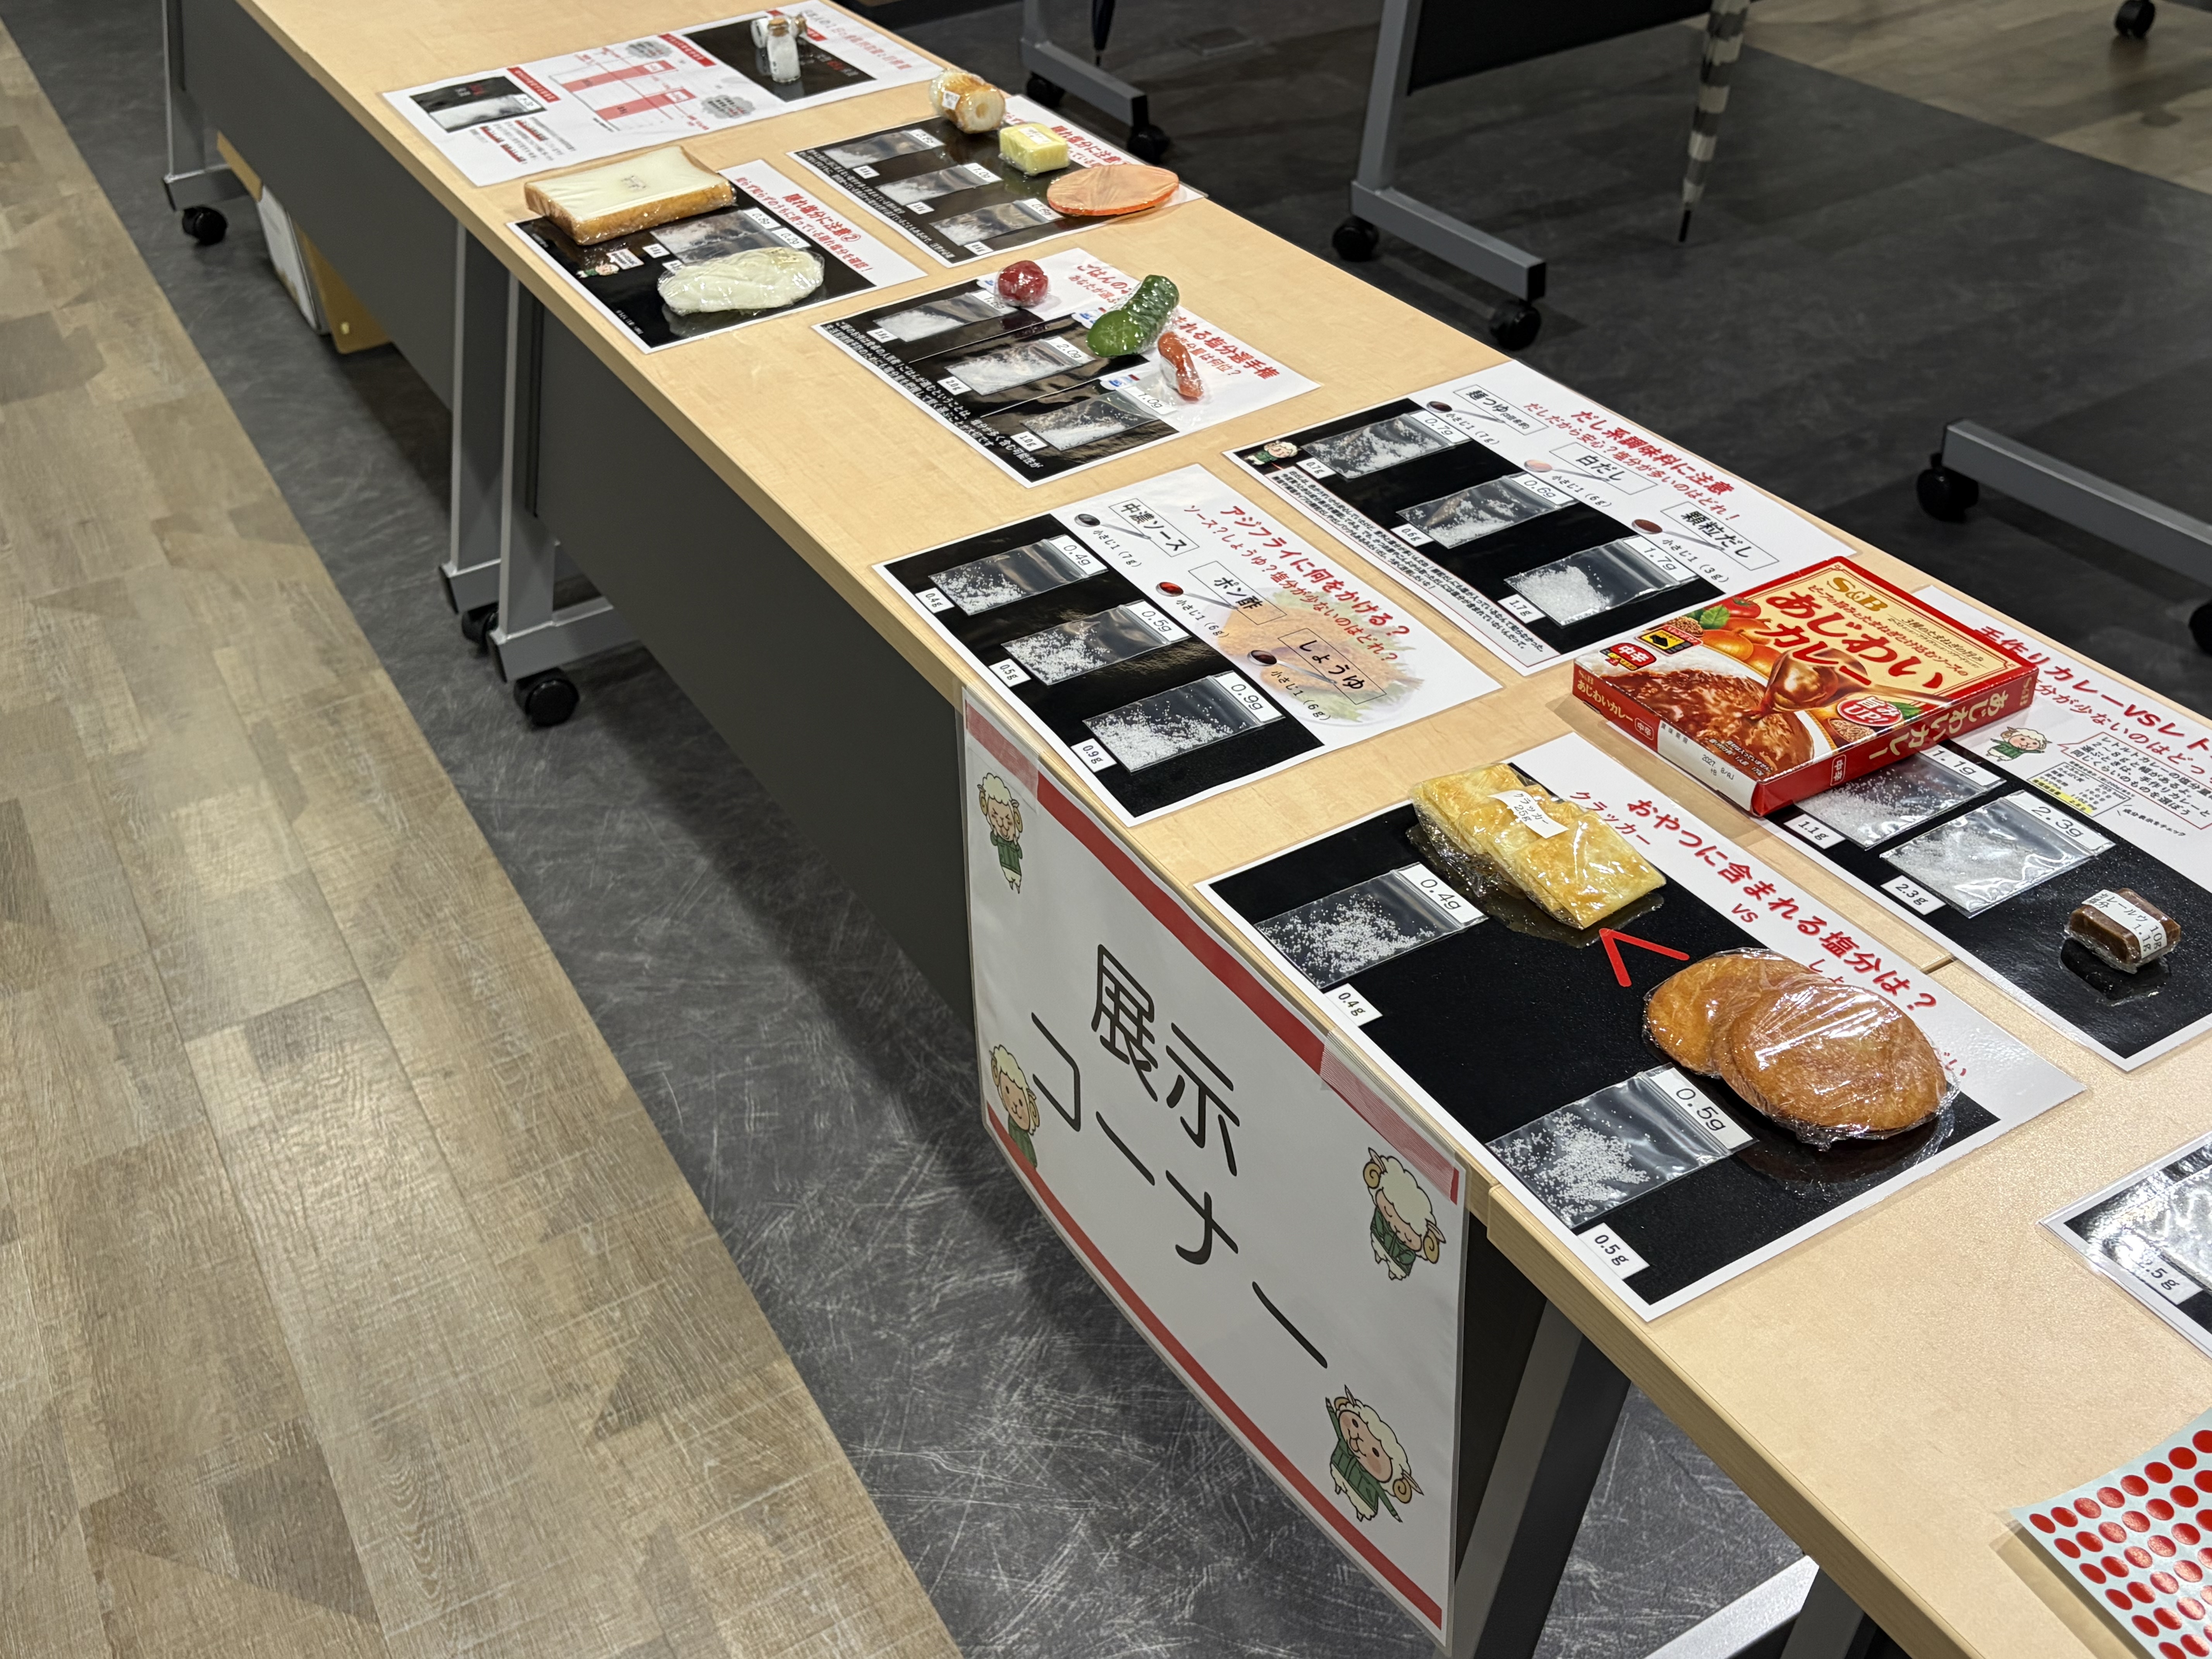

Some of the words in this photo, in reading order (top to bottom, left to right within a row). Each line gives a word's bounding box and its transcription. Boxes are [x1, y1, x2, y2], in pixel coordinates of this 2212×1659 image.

[1048, 125, 1130, 165] 隠れ塩分に注意
[1053, 344, 1082, 360] 2.0g
[1019, 436, 1037, 447] 1.0g
[1425, 419, 1454, 435] 0.7g
[1524, 404, 1740, 520] だしだから安心？塩分が多いのはどれ！
[1571, 411, 1734, 495] だし系調味料に注意
[1306, 462, 1325, 474] 0.7g
[1576, 454, 1630, 482] 白だし
[1524, 479, 1556, 500] 0.6g
[1117, 502, 1191, 552] 中濃ソース
[1401, 529, 1422, 541] 0.6g
[1677, 510, 1763, 558] 顆粒だし
[1063, 545, 1091, 565] 0.4g
[1637, 548, 1685, 570] 1.7g
[1182, 505, 1399, 663] ソース？しょうゆ？塩分が少ないのはどれ？
[1218, 505, 1412, 639] アジフライに何をかける？
[926, 593, 943, 607] 0.4g
[1210, 576, 1266, 611] ポン酢
[1509, 600, 1532, 616] 1.7g
[1828, 577, 1889, 612] S&B
[1142, 611, 1172, 632] 0.5g
[1806, 585, 1971, 677] ビーフの旨みとたまねぎとけ込むソースの
[1615, 644, 1650, 663] 中辛
[1754, 622, 1872, 686] カレー
[1767, 591, 1943, 689] あじわい
[1000, 665, 1018, 680] 0.5g
[1296, 641, 1370, 691] しょうゆ
[1231, 684, 1263, 710] 0.9g
[1577, 679, 1633, 723] あじわいカレー
[1637, 721, 1652, 737] 中辛
[1858, 696, 1902, 718] 旨み
[1844, 704, 1885, 724] UP!
[1868, 690, 2009, 765] あじわいカレー
[2034, 681, 2212, 783] 分が少ないのはどっ
[1083, 745, 1103, 764] 0.9g
[1932, 749, 1978, 776] 1.1g
[1832, 759, 1843, 781] 中辛
[2070, 749, 2191, 816] 同じくらいのものを選ぼう
[1514, 793, 1548, 824] クラッカー
[1514, 805, 1534, 821] 25g
[2031, 807, 2084, 837] 2.3g
[1798, 821, 1829, 840] 1.1g
[1568, 789, 1658, 848] クラッカー
[1731, 903, 1758, 922] VS
[1420, 879, 1461, 909] 0.4g
[1623, 798, 1938, 1013] おやつに含まれる塩分は？
[1895, 884, 1928, 905] 2.3g
[2132, 924, 2156, 953] 1.1g
[2148, 926, 2163, 950] 10g
[1338, 993, 1365, 1016] 0.4g
[1091, 942, 1240, 1178] 展示
[1667, 1089, 1736, 1131] 0.5g
[1029, 1010, 1328, 1370] コーナー
[1595, 1235, 1629, 1266] 0.5g
